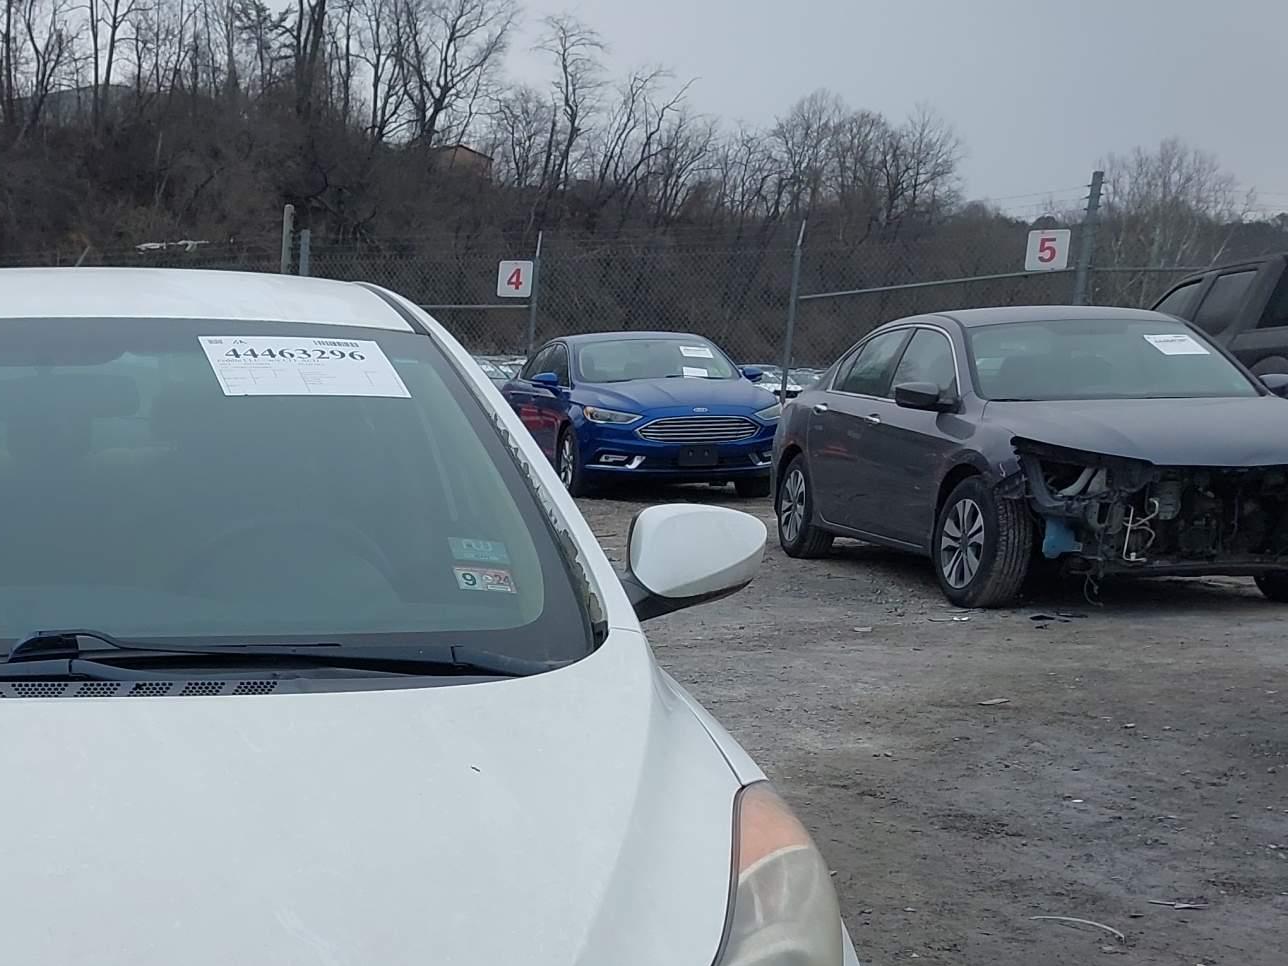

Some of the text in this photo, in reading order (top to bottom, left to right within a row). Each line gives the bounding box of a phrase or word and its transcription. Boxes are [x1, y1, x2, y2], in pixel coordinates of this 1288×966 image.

[1038, 237, 1057, 262] 5
[506, 268, 523, 290] 4
[224, 346, 366, 362] 44463296
[461, 572, 477, 586] 9
